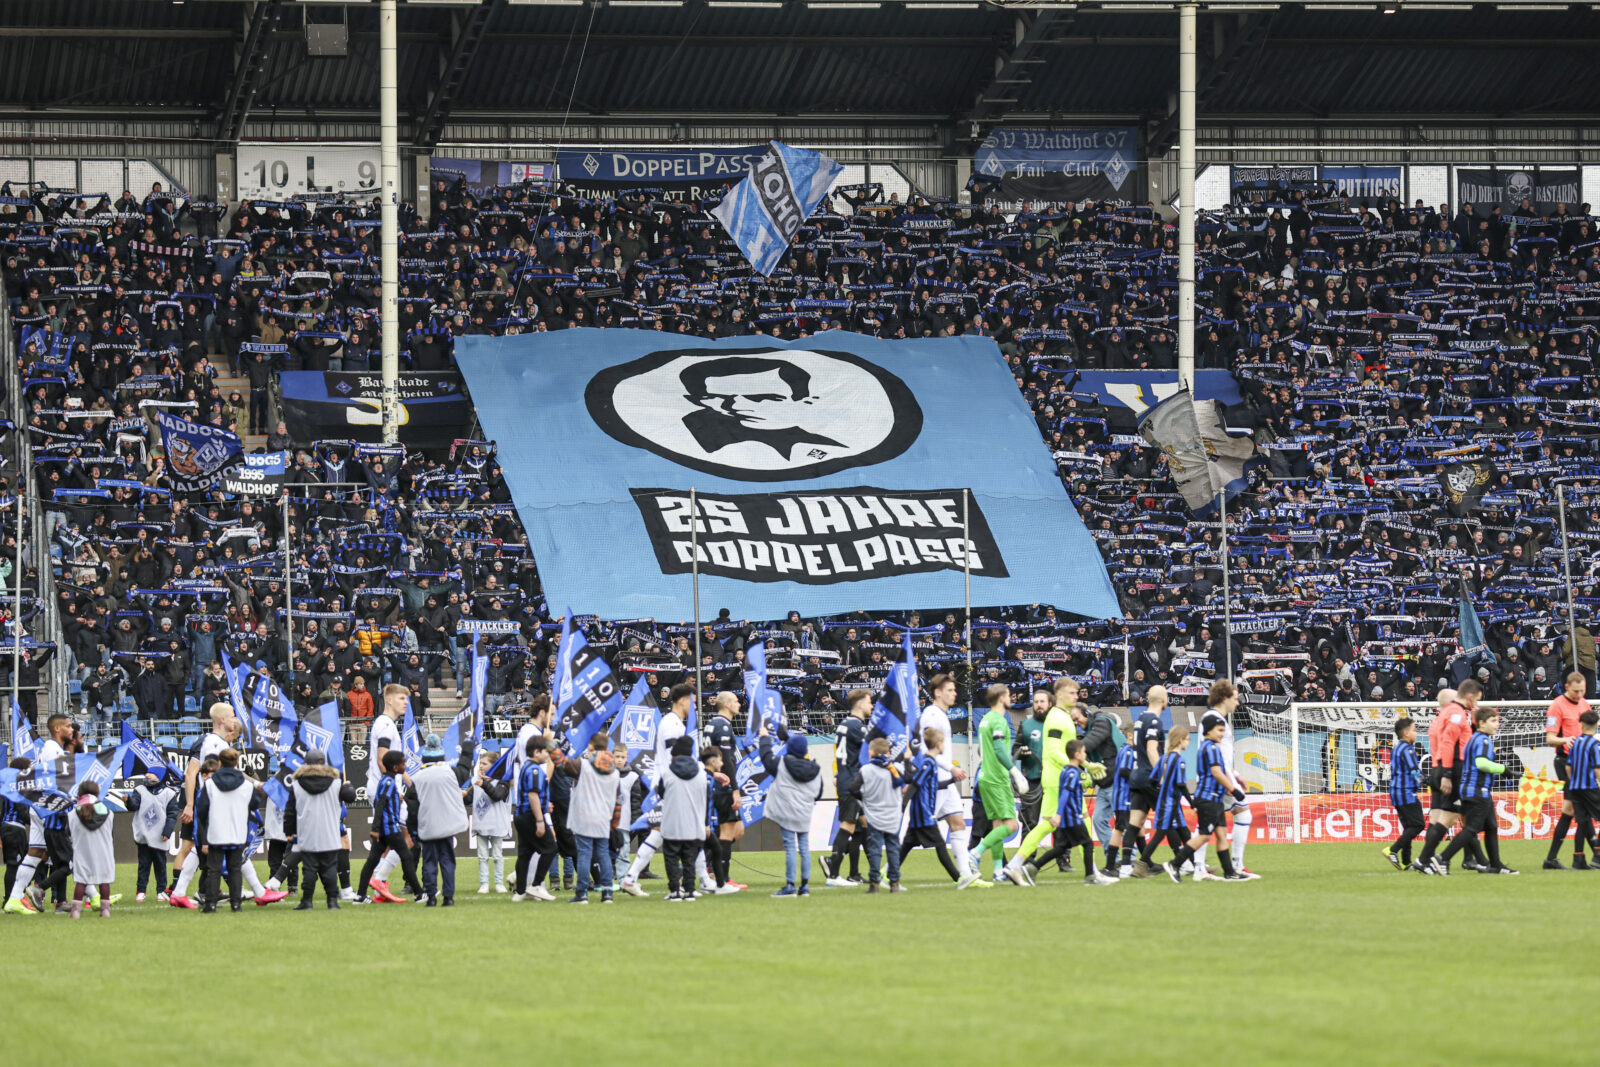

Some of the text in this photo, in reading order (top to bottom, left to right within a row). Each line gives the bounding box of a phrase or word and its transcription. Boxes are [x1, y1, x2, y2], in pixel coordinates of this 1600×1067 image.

[1104, 131, 1128, 149] 07
[1063, 160, 1099, 177] Club
[1461, 182, 1578, 204] OLD DIRTY BASTARDS
[225, 479, 279, 495] WALDHOF
[654, 494, 966, 536] 25 JAHRE
[671, 532, 985, 576] DOPPELPASS
[464, 621, 514, 632] BARACKLER
[1229, 618, 1279, 633] BARACKLER
[495, 722, 509, 731] 12
